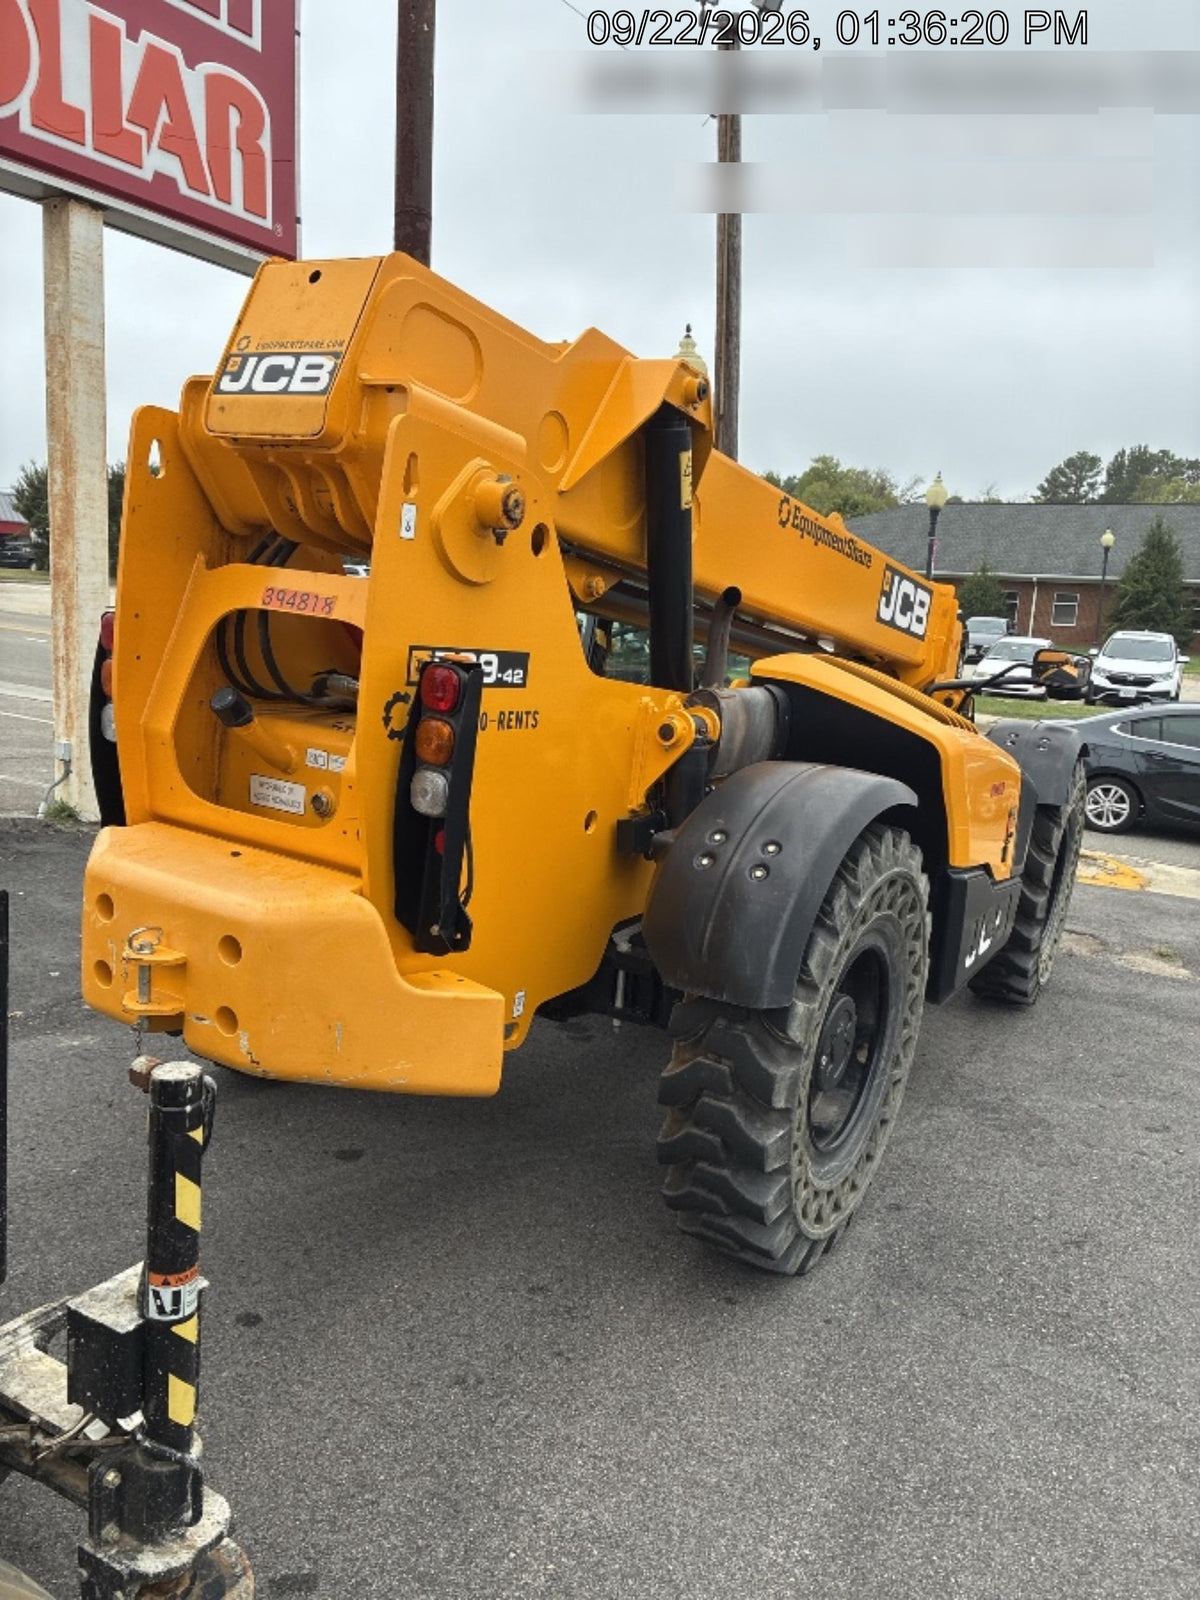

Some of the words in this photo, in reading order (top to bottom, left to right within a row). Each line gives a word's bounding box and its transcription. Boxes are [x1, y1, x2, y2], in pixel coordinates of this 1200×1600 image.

[219, 354, 338, 392] JCB
[790, 504, 872, 569] EquipmentShare
[878, 574, 931, 636] JCB
